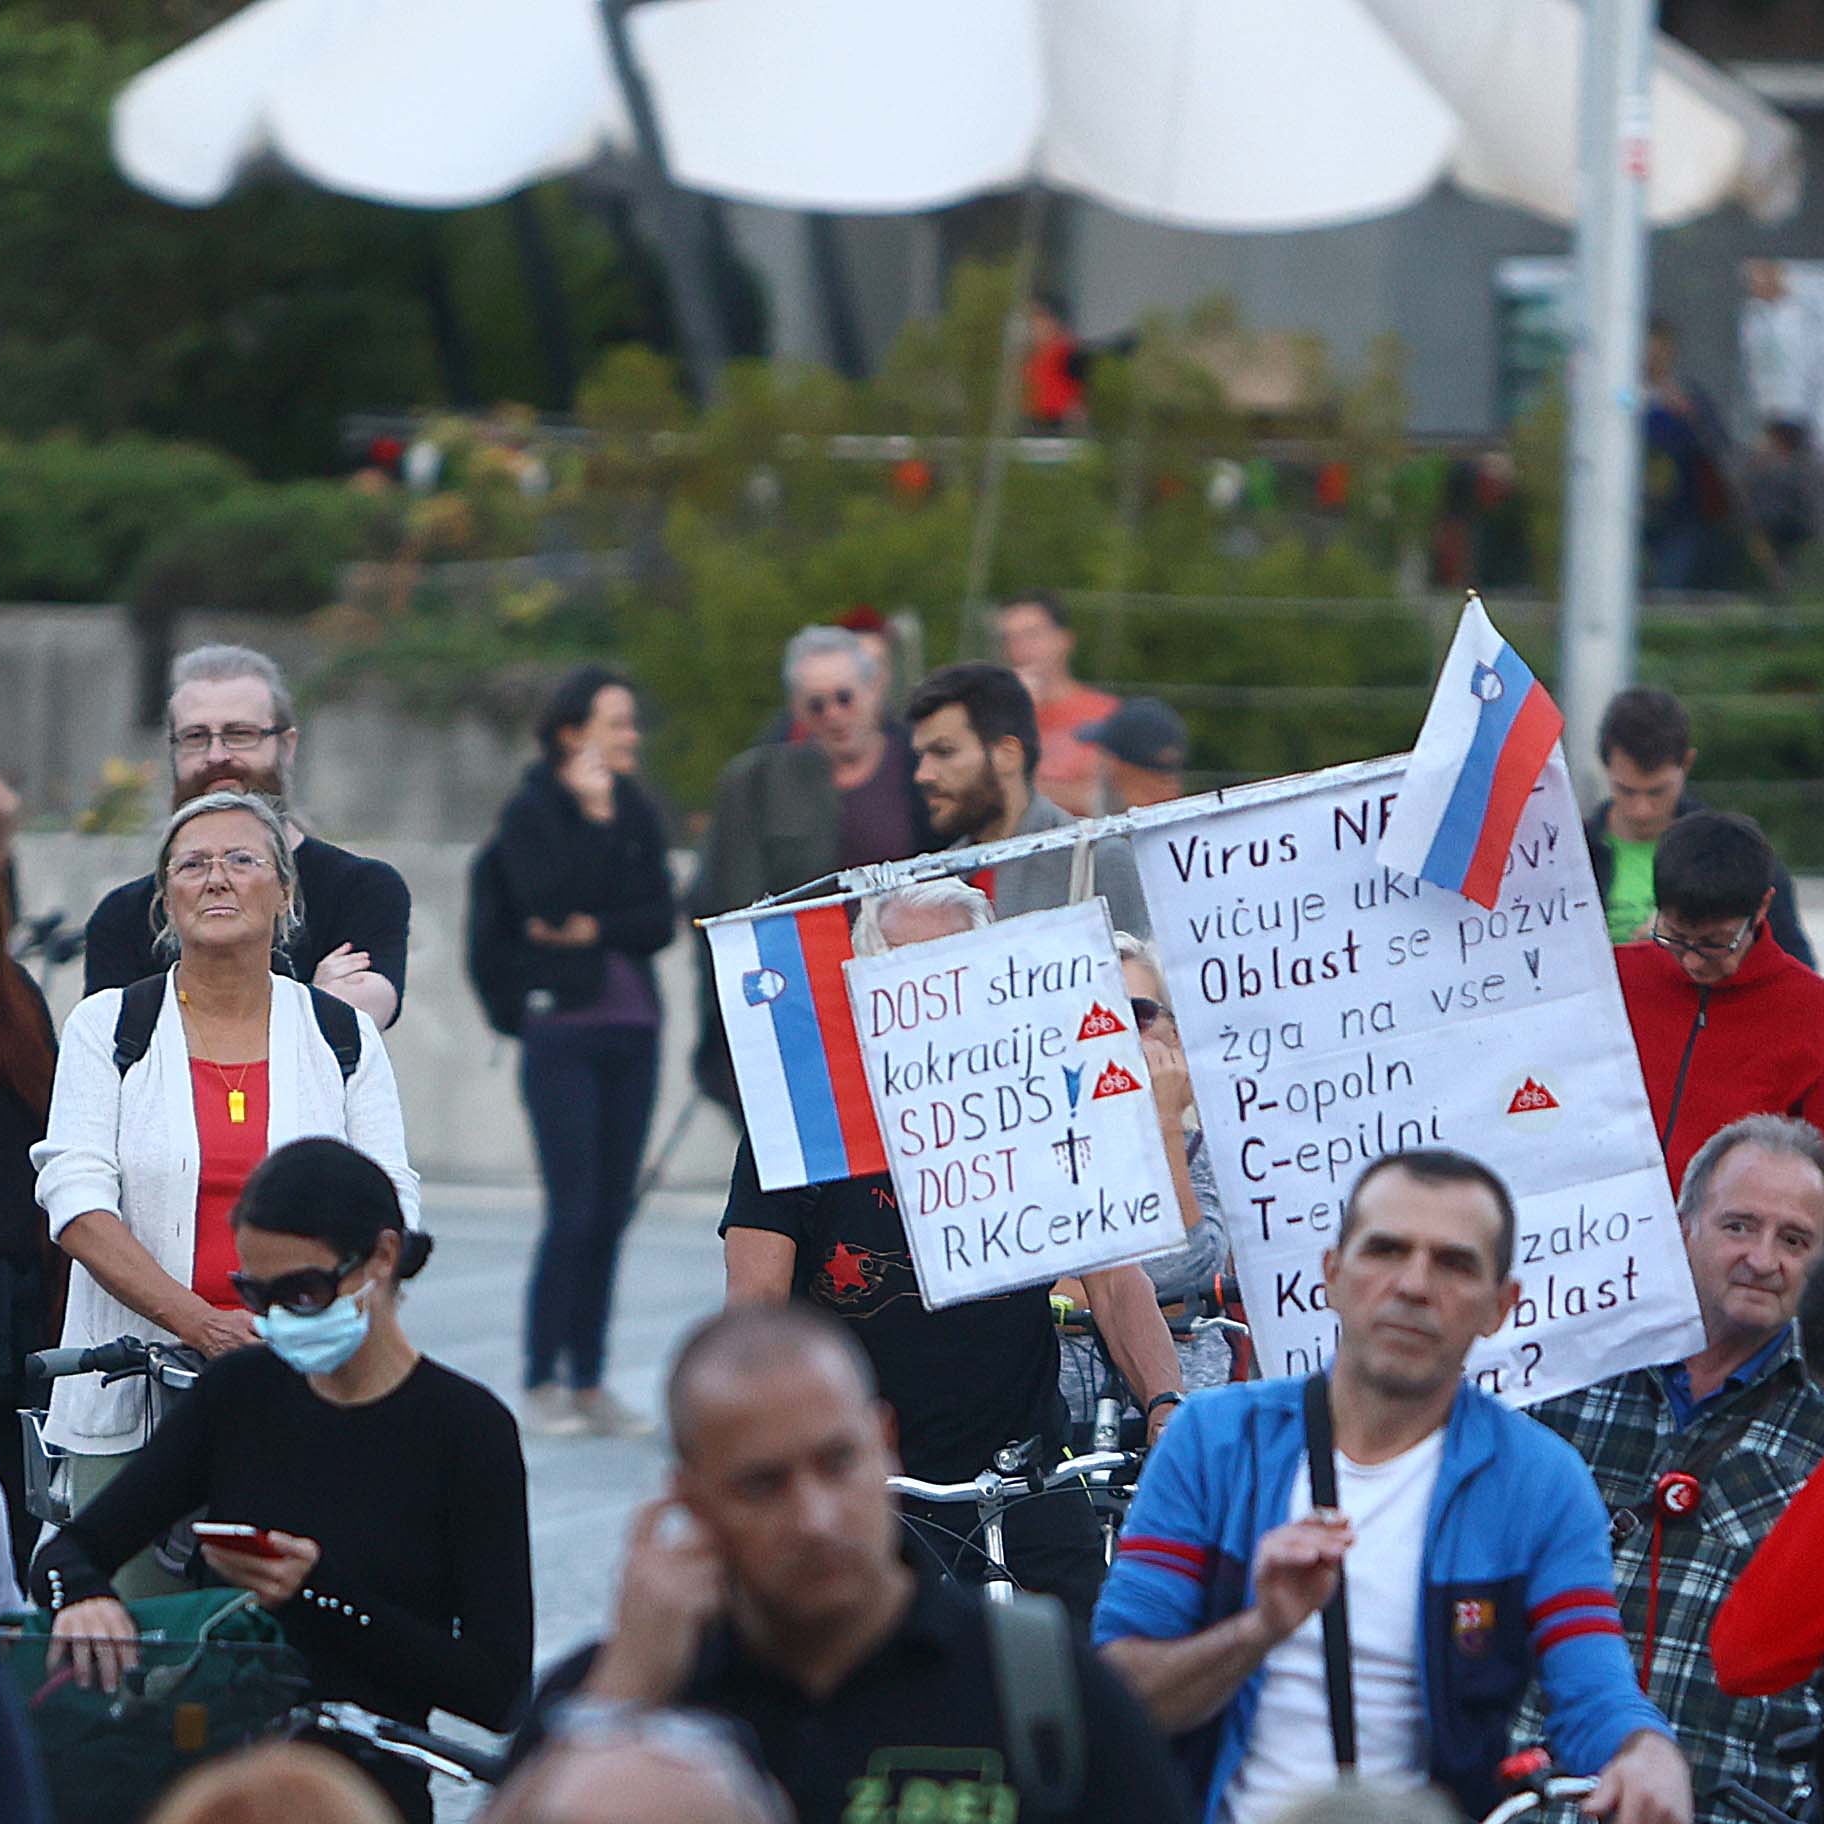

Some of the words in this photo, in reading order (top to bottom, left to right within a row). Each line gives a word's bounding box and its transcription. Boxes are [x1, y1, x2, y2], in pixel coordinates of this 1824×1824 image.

[1168, 832, 1298, 883] Virus
[1200, 929, 1362, 1004] Oblast
[1387, 927, 1432, 967] se
[1458, 887, 1590, 964] požvi-
[869, 965, 970, 1038] DOST
[987, 953, 1111, 1006] stran-
[883, 1023, 1068, 1097] kokracije
[1218, 1022, 1306, 1074] žga
[1340, 1000, 1397, 1040] na
[1235, 1053, 1414, 1123] P-opoln
[917, 1147, 1019, 1216] DOST
[1521, 1204, 1656, 1265] zako-
[1512, 1256, 1640, 1328] blast
